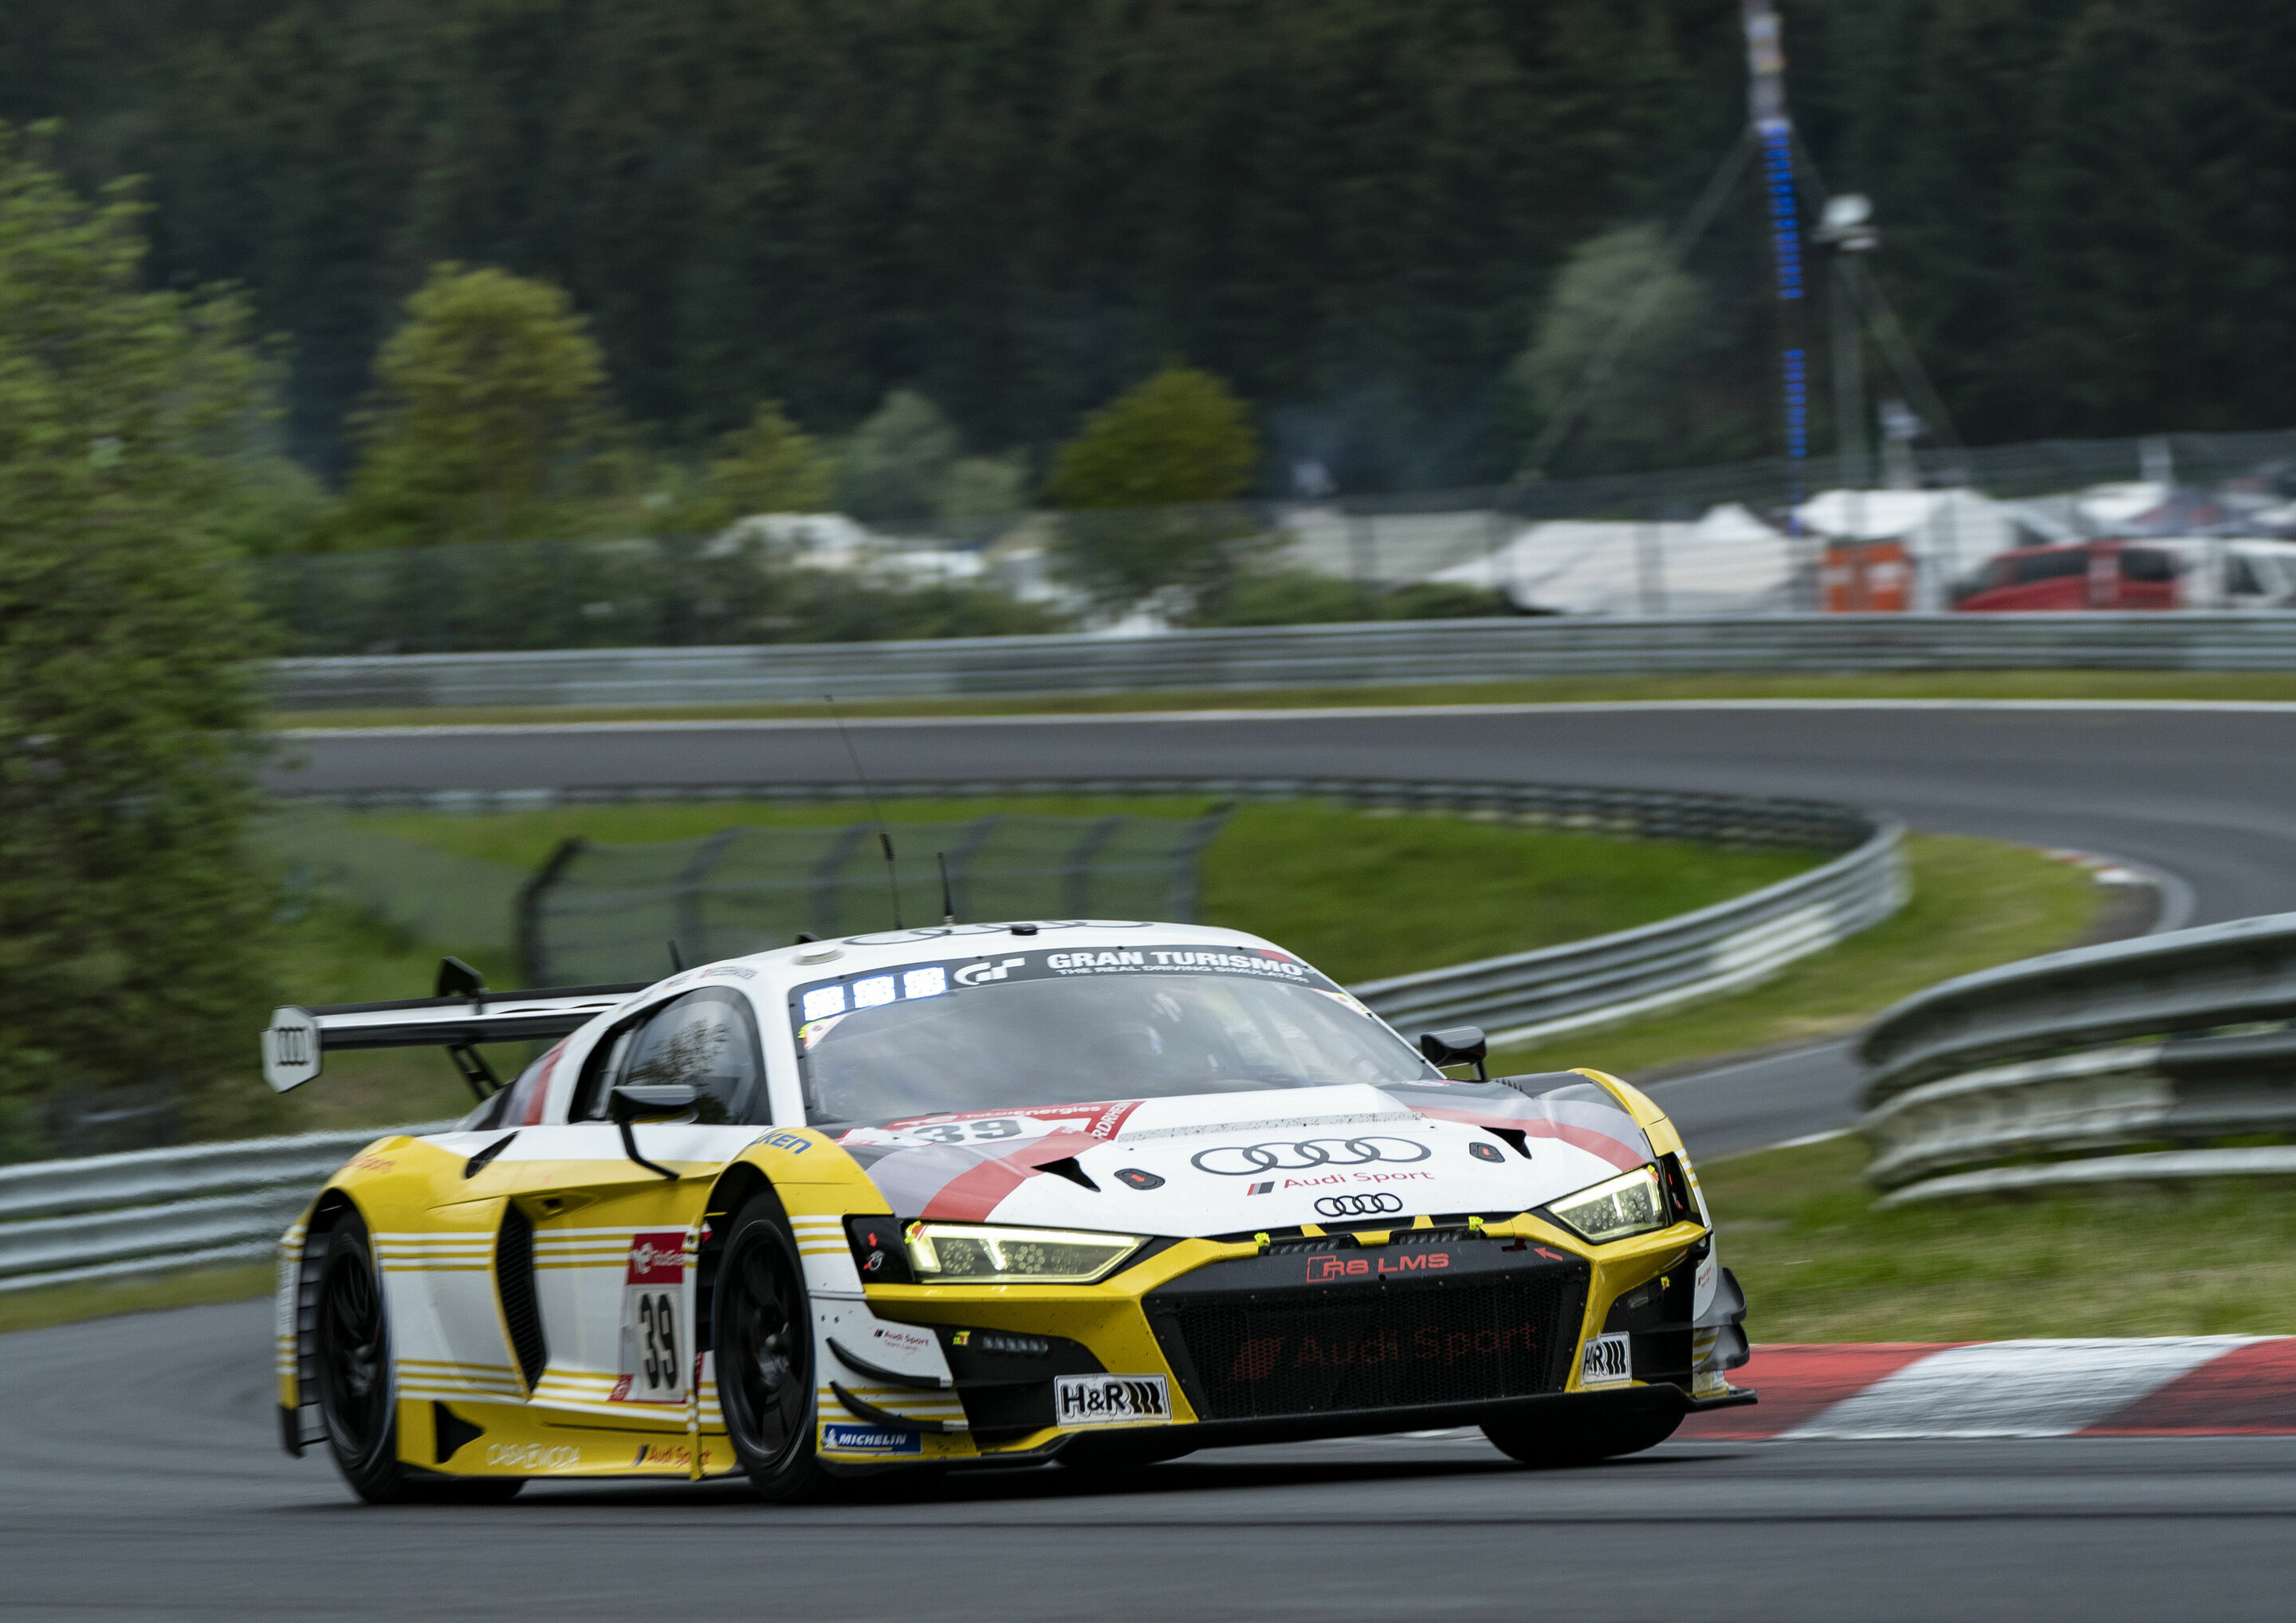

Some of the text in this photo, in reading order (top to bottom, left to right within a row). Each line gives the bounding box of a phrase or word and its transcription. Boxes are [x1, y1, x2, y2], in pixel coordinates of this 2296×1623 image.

[1047, 951, 1304, 977] GRAN TURISMO
[1214, 966, 1311, 984] SIMULATOR
[913, 1119, 1023, 1144] 39
[1284, 1171, 1435, 1189] Audi Sport
[1323, 1252, 1449, 1277] R8 LMS
[641, 1293, 677, 1389] 39
[1293, 1321, 1538, 1369] Audi Sport
[1062, 1383, 1126, 1414] H&R
[838, 1433, 907, 1446] MICHELIN
